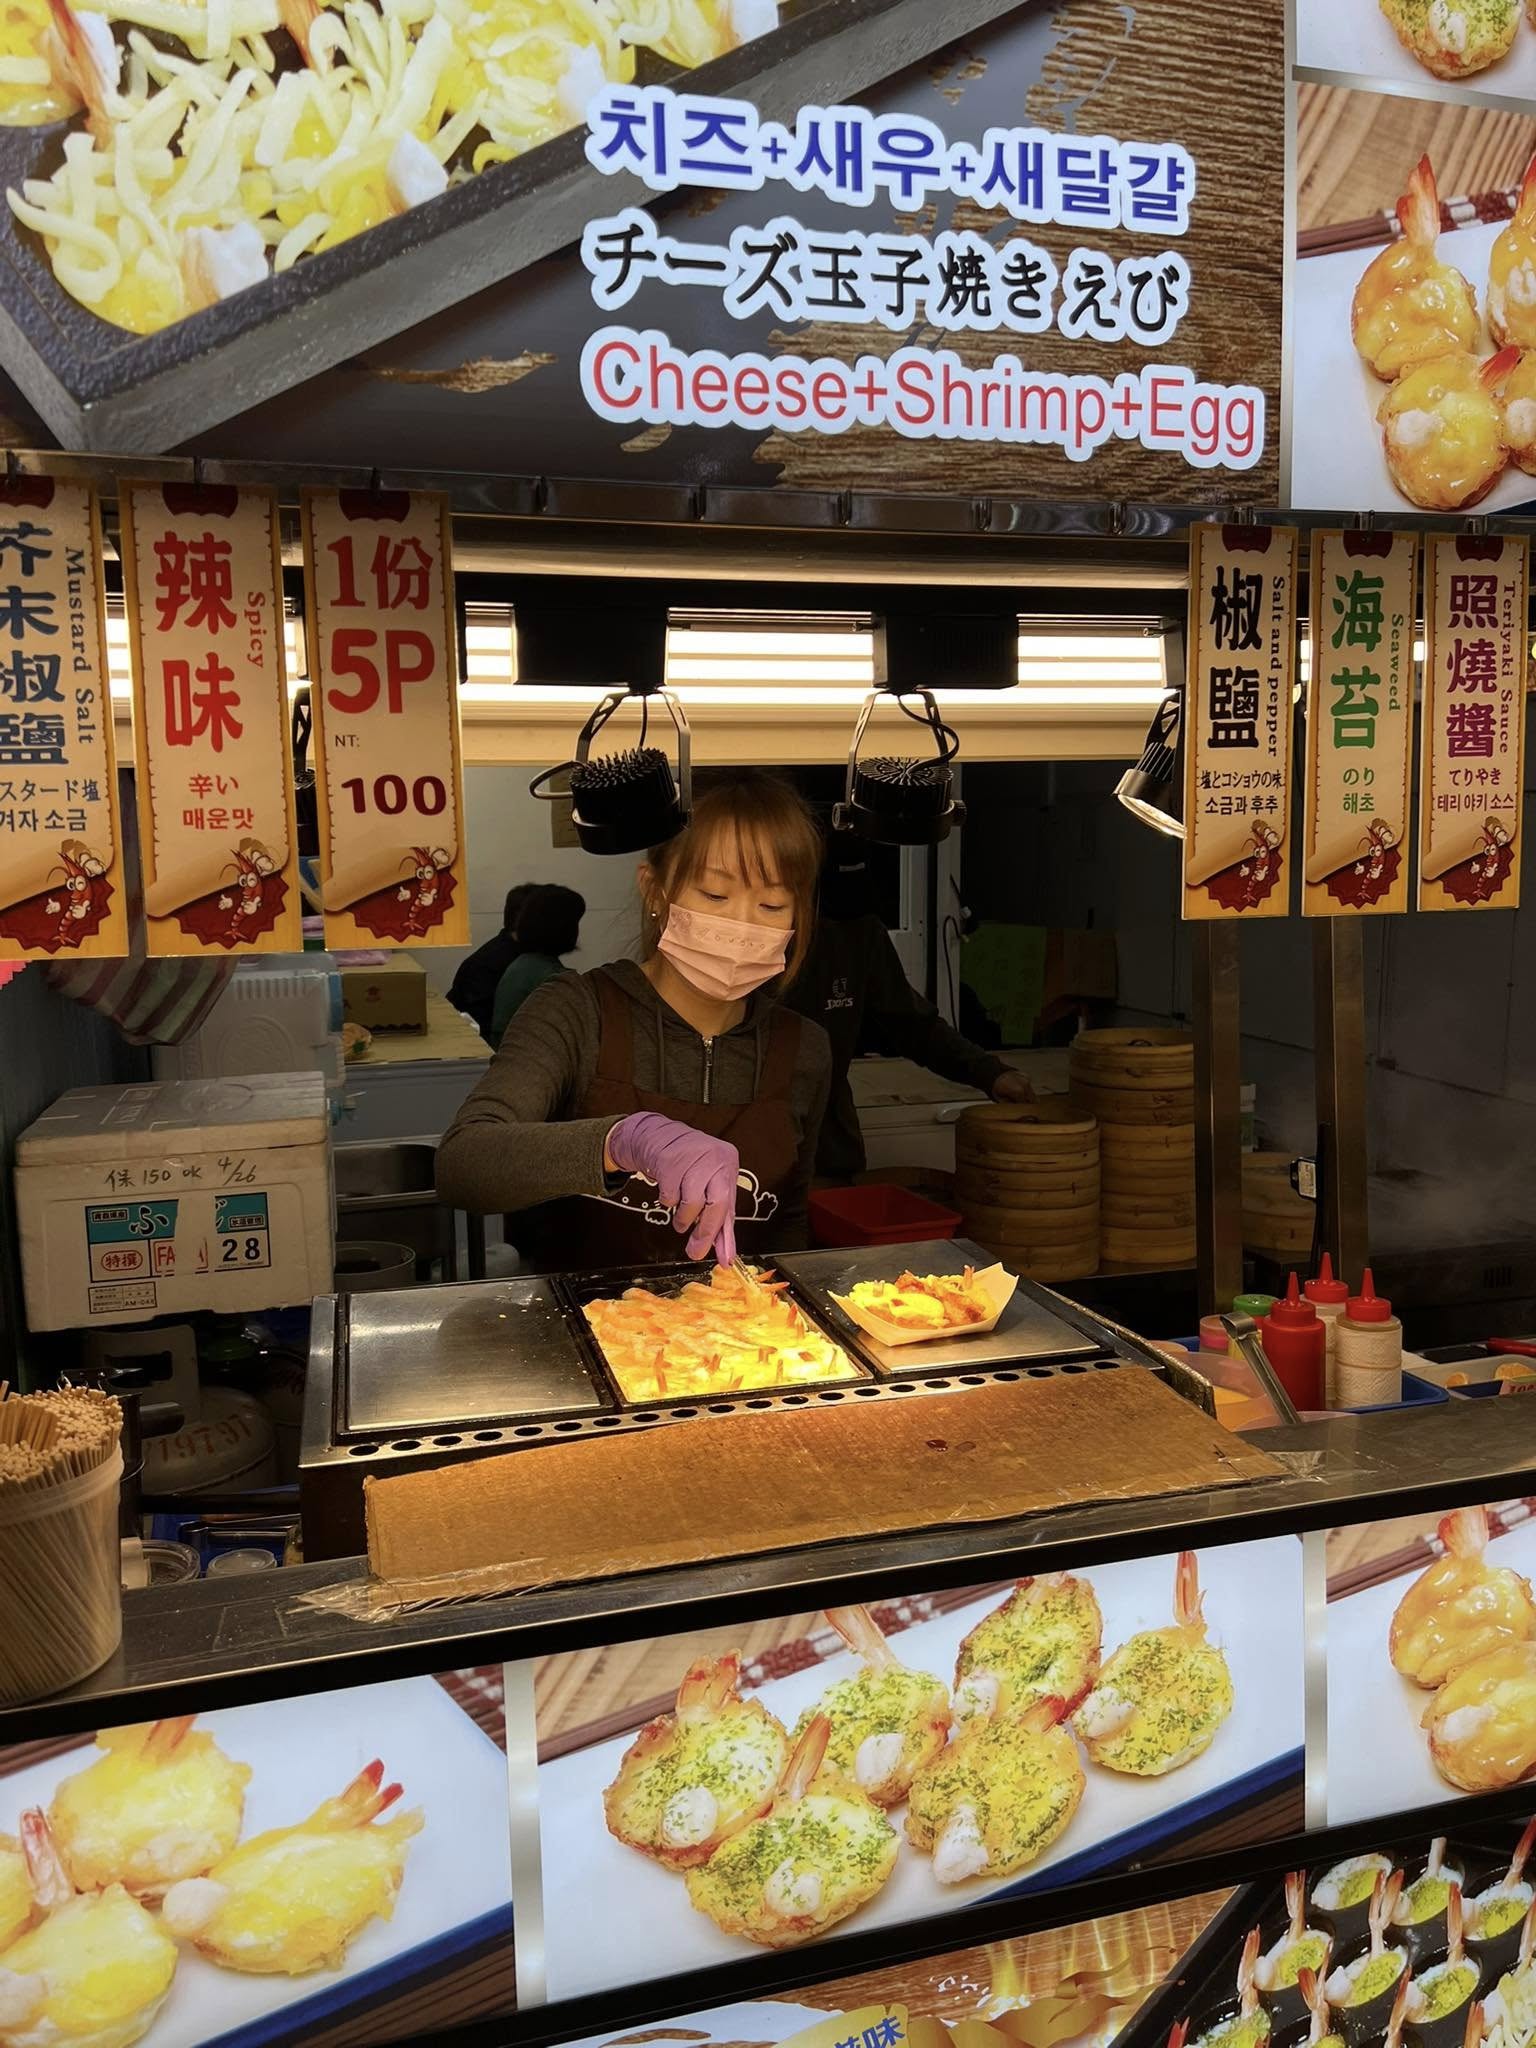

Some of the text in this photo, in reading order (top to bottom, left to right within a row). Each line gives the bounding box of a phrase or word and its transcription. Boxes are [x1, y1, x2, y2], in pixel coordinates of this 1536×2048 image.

[594, 222, 1180, 332] チーズ玉子焼きえび
[592, 340, 1256, 457] Cheese+Shrimp+Egg
[327, 535, 434, 610] 1份
[66, 546, 96, 743] Mustard Salt
[153, 530, 244, 753] 辣味
[247, 590, 266, 669] Spicy
[1207, 565, 1264, 749] 椒鹽
[1265, 576, 1285, 758] Salt and pepper
[1331, 570, 1384, 749] 海苔
[1388, 614, 1404, 712] Seaweed
[1446, 575, 1499, 759] 照燒醬
[1499, 580, 1516, 753] Teriyaki Sauce
[328, 628, 435, 714] 5P
[335, 734, 361, 748] NT:
[1342, 767, 1375, 786] のり
[1449, 767, 1502, 787] てりやき
[188, 774, 240, 799] 辛い
[342, 774, 447, 816] 100
[1201, 769, 1283, 791] 塩とコショウの味
[1205, 795, 1278, 816] 소금과 후추
[1342, 792, 1375, 813] 해초
[1490, 793, 1514, 812] 소스
[44, 808, 88, 832] 소금
[182, 807, 255, 831] 매운맛
[143, 1168, 171, 1185] 150
